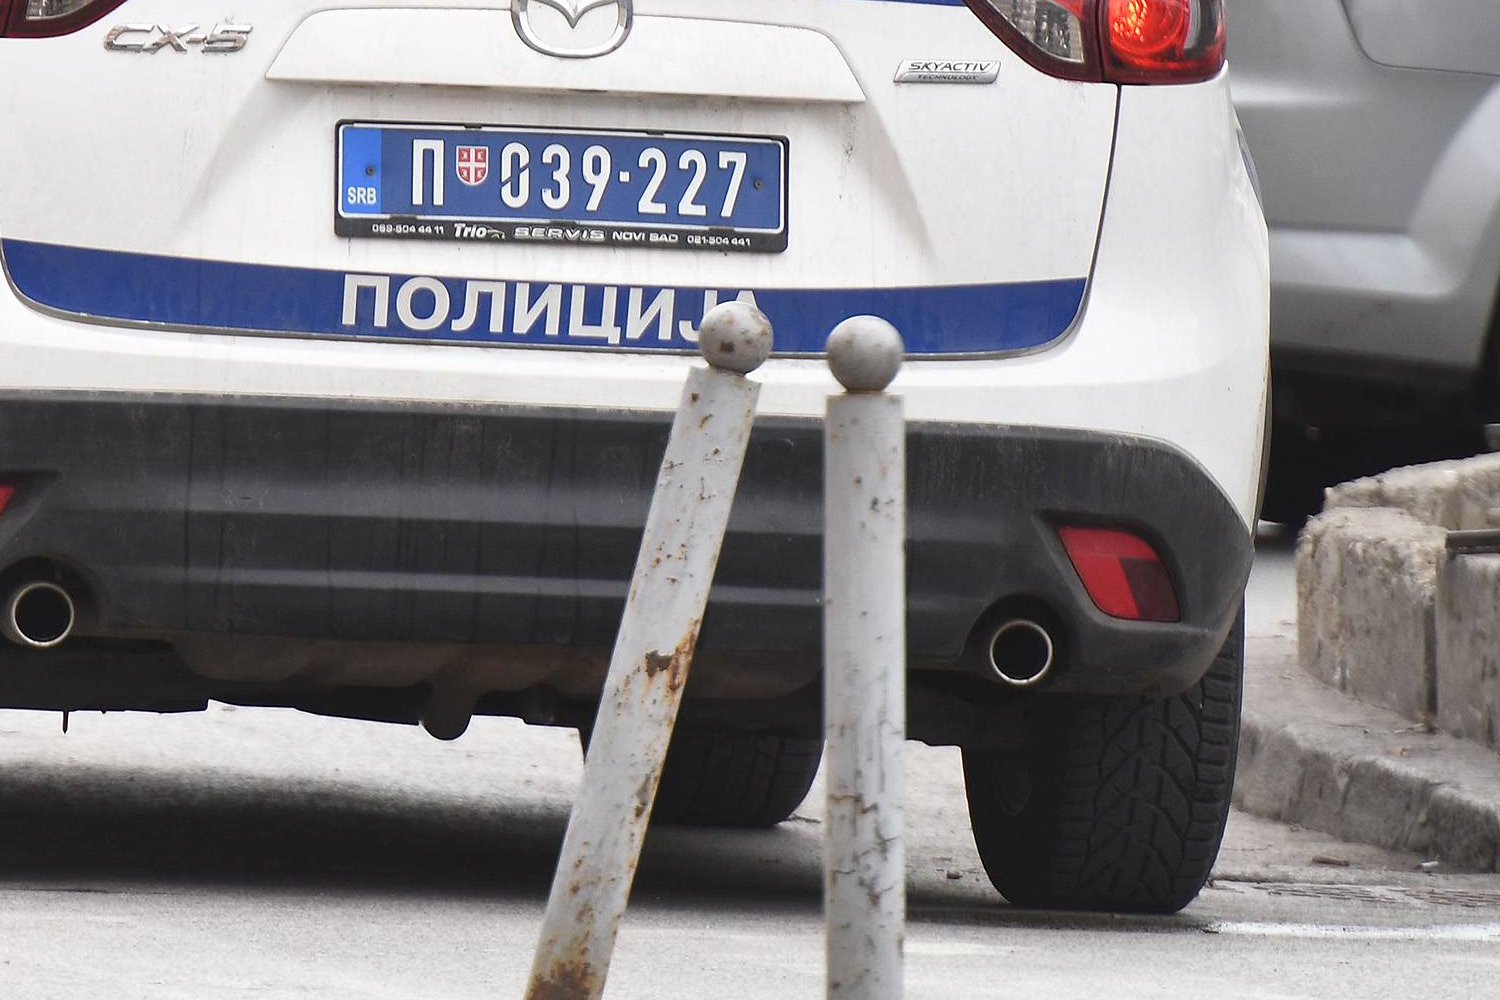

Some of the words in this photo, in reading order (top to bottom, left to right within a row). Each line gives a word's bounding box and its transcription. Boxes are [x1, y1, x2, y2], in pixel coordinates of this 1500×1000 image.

[103, 23, 253, 53] CX-5
[907, 61, 991, 72] SKYACTIV
[917, 73, 978, 81] TECHNOLOGY
[347, 186, 377, 205] SRB
[453, 222, 488, 239] Trio
[513, 226, 606, 242] SERVIS
[612, 231, 646, 241] NOVI
[649, 232, 679, 243] SAD
[341, 273, 758, 345] ПОЛИЦИЈ
